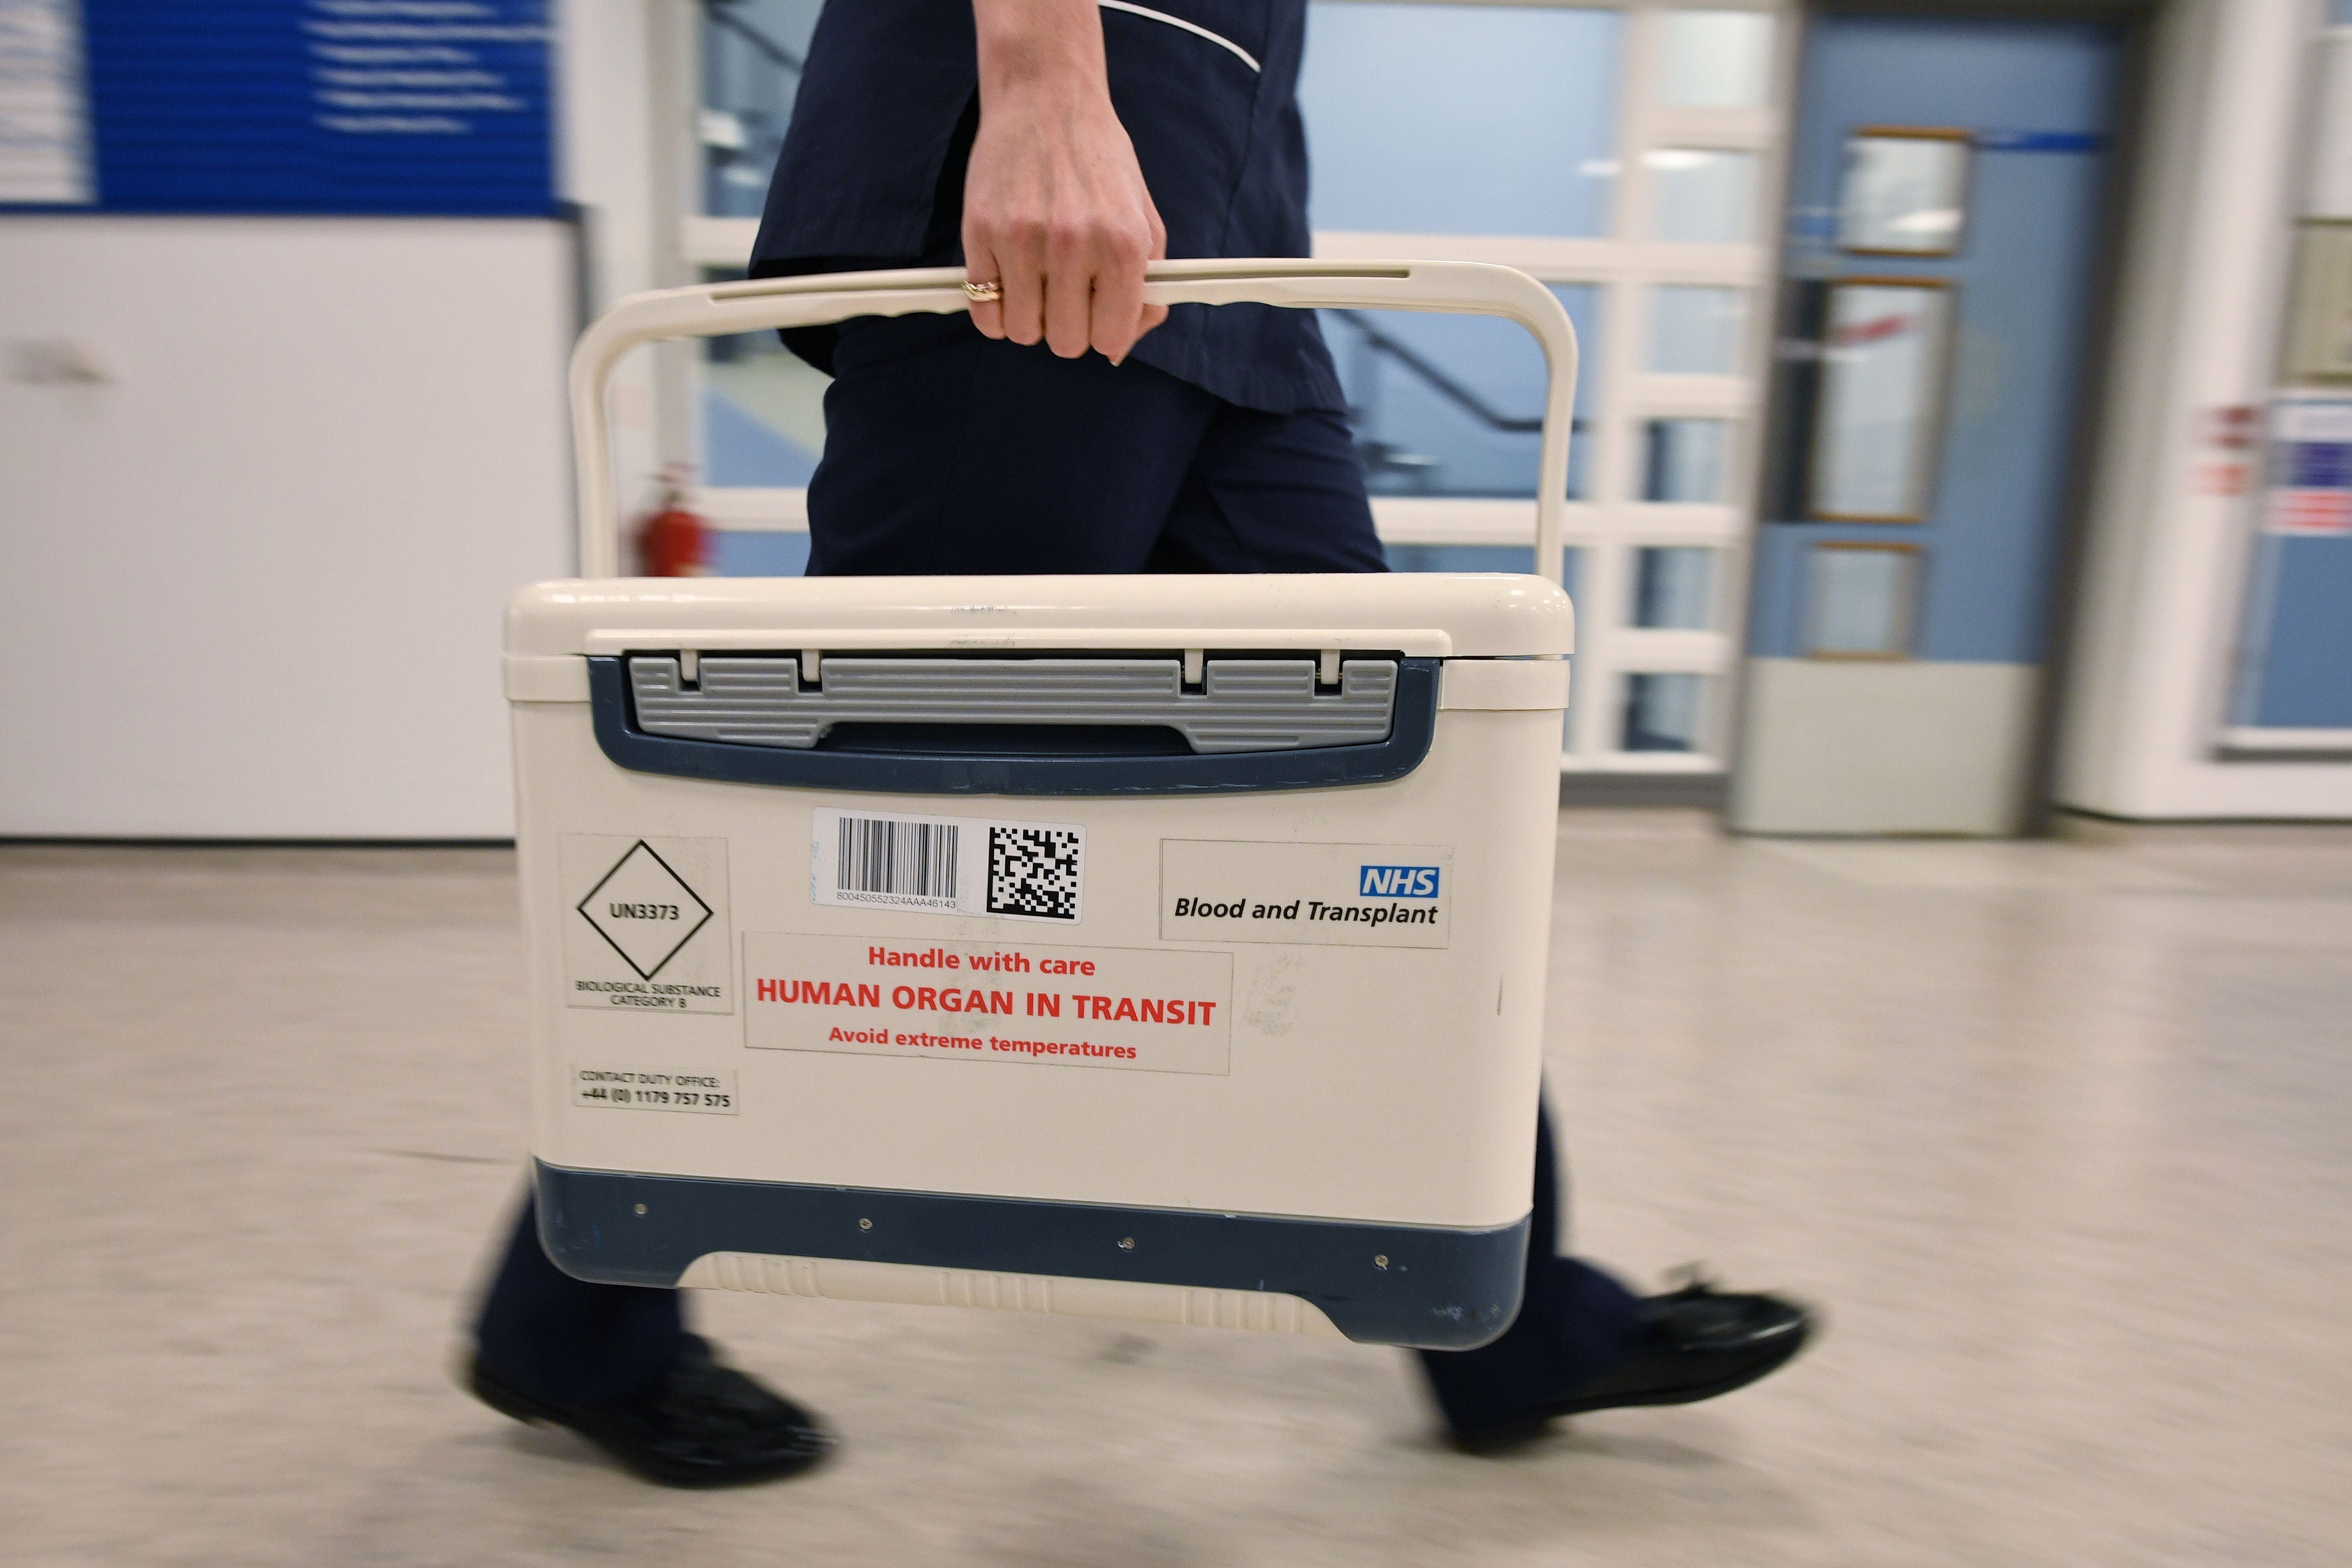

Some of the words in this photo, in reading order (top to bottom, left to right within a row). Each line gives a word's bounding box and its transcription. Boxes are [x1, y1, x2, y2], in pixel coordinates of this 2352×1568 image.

[1362, 867, 1436, 896] NHS
[837, 891, 956, 909] 800450552324AAA46143
[610, 903, 679, 920] UN3373
[1175, 898, 1245, 919] Blood
[1251, 900, 1300, 920] and
[1308, 902, 1438, 927] Transplant
[869, 947, 960, 969] Handle
[969, 952, 1030, 973] with
[1040, 959, 1095, 975] care
[575, 980, 648, 994] BIOLOGICAL
[651, 984, 721, 997] SUBSTANCE
[610, 995, 675, 1007] CATEGORY
[678, 998, 687, 1008] B
[757, 978, 880, 1008] HUMAN
[892, 986, 1013, 1014] ORGAN
[1027, 993, 1060, 1017] IN
[1073, 995, 1216, 1026] TRANSIT
[829, 1027, 888, 1044] Avoid
[896, 1033, 982, 1050] extreme
[990, 1037, 1136, 1059] temperatures
[579, 1070, 634, 1083] CONTACT
[638, 1074, 671, 1085] DUTY
[635, 1090, 669, 1104] 1179
[673, 1092, 700, 1105] 757
[704, 1094, 730, 1107] 575
